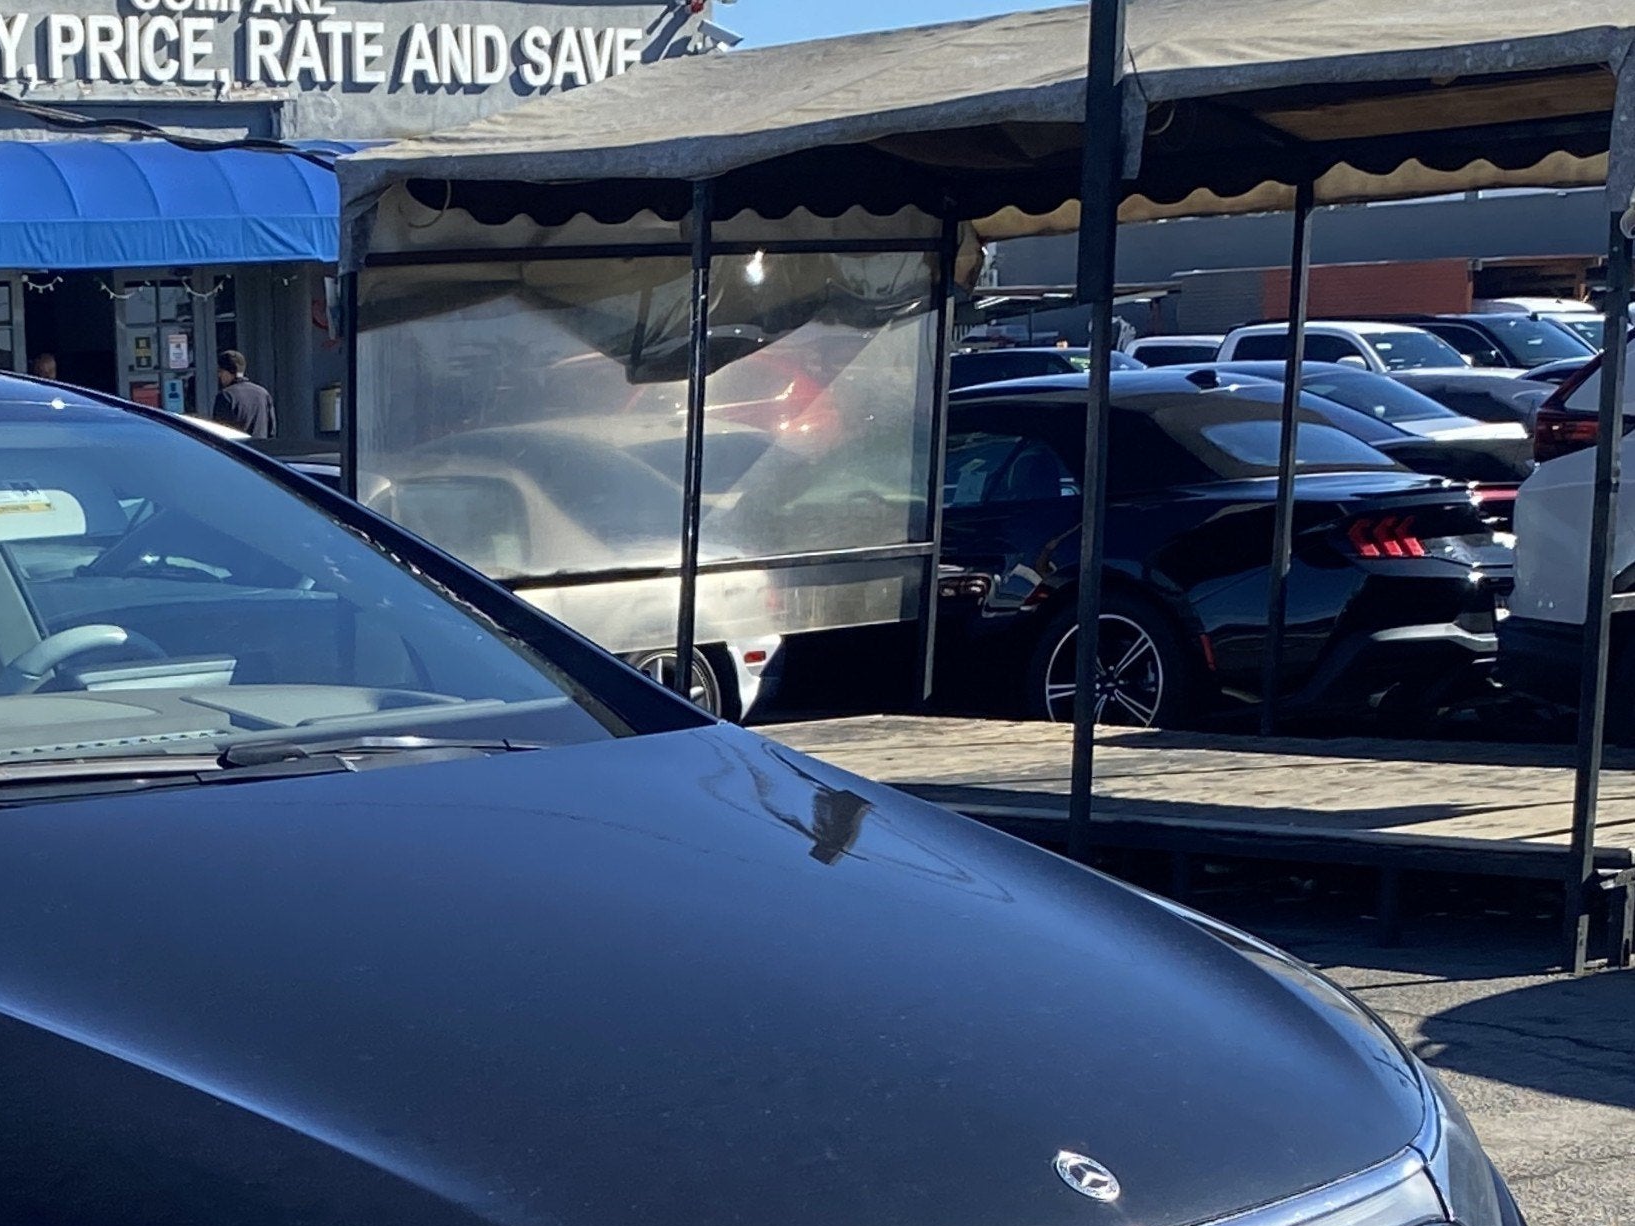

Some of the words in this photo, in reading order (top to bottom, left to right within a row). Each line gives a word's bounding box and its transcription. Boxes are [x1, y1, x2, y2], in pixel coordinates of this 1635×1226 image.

[46, 13, 229, 92] PRICE,
[248, 17, 386, 84] RATE
[400, 21, 510, 86] AND
[517, 24, 643, 87] SAVE
